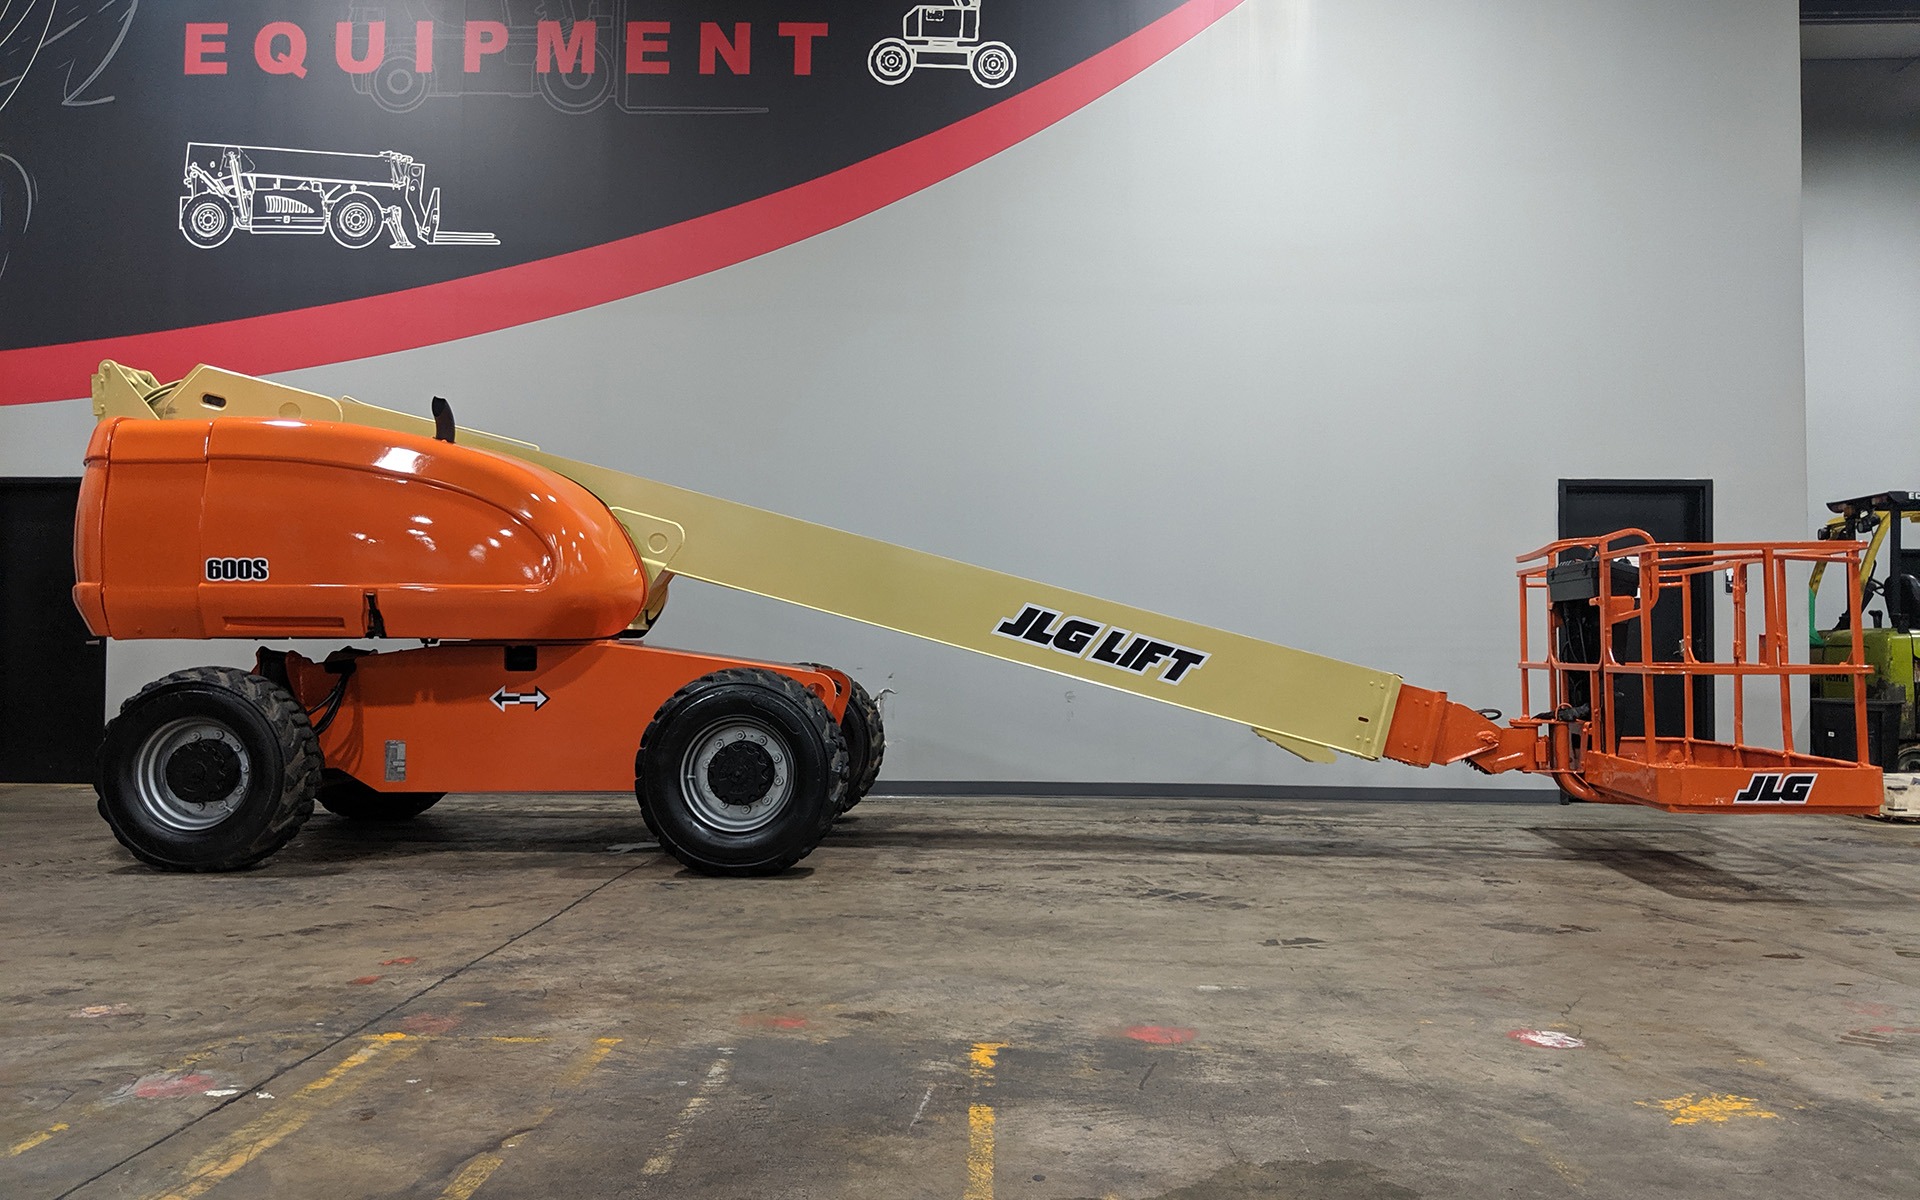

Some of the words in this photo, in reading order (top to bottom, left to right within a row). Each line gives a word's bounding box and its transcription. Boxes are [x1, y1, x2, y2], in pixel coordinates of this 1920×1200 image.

[183, 21, 829, 79] EQUIPMENT
[206, 558, 268, 580] 600S
[995, 605, 1102, 655] JLG
[1089, 628, 1207, 683] LIFT
[1735, 775, 1816, 803] JLG
